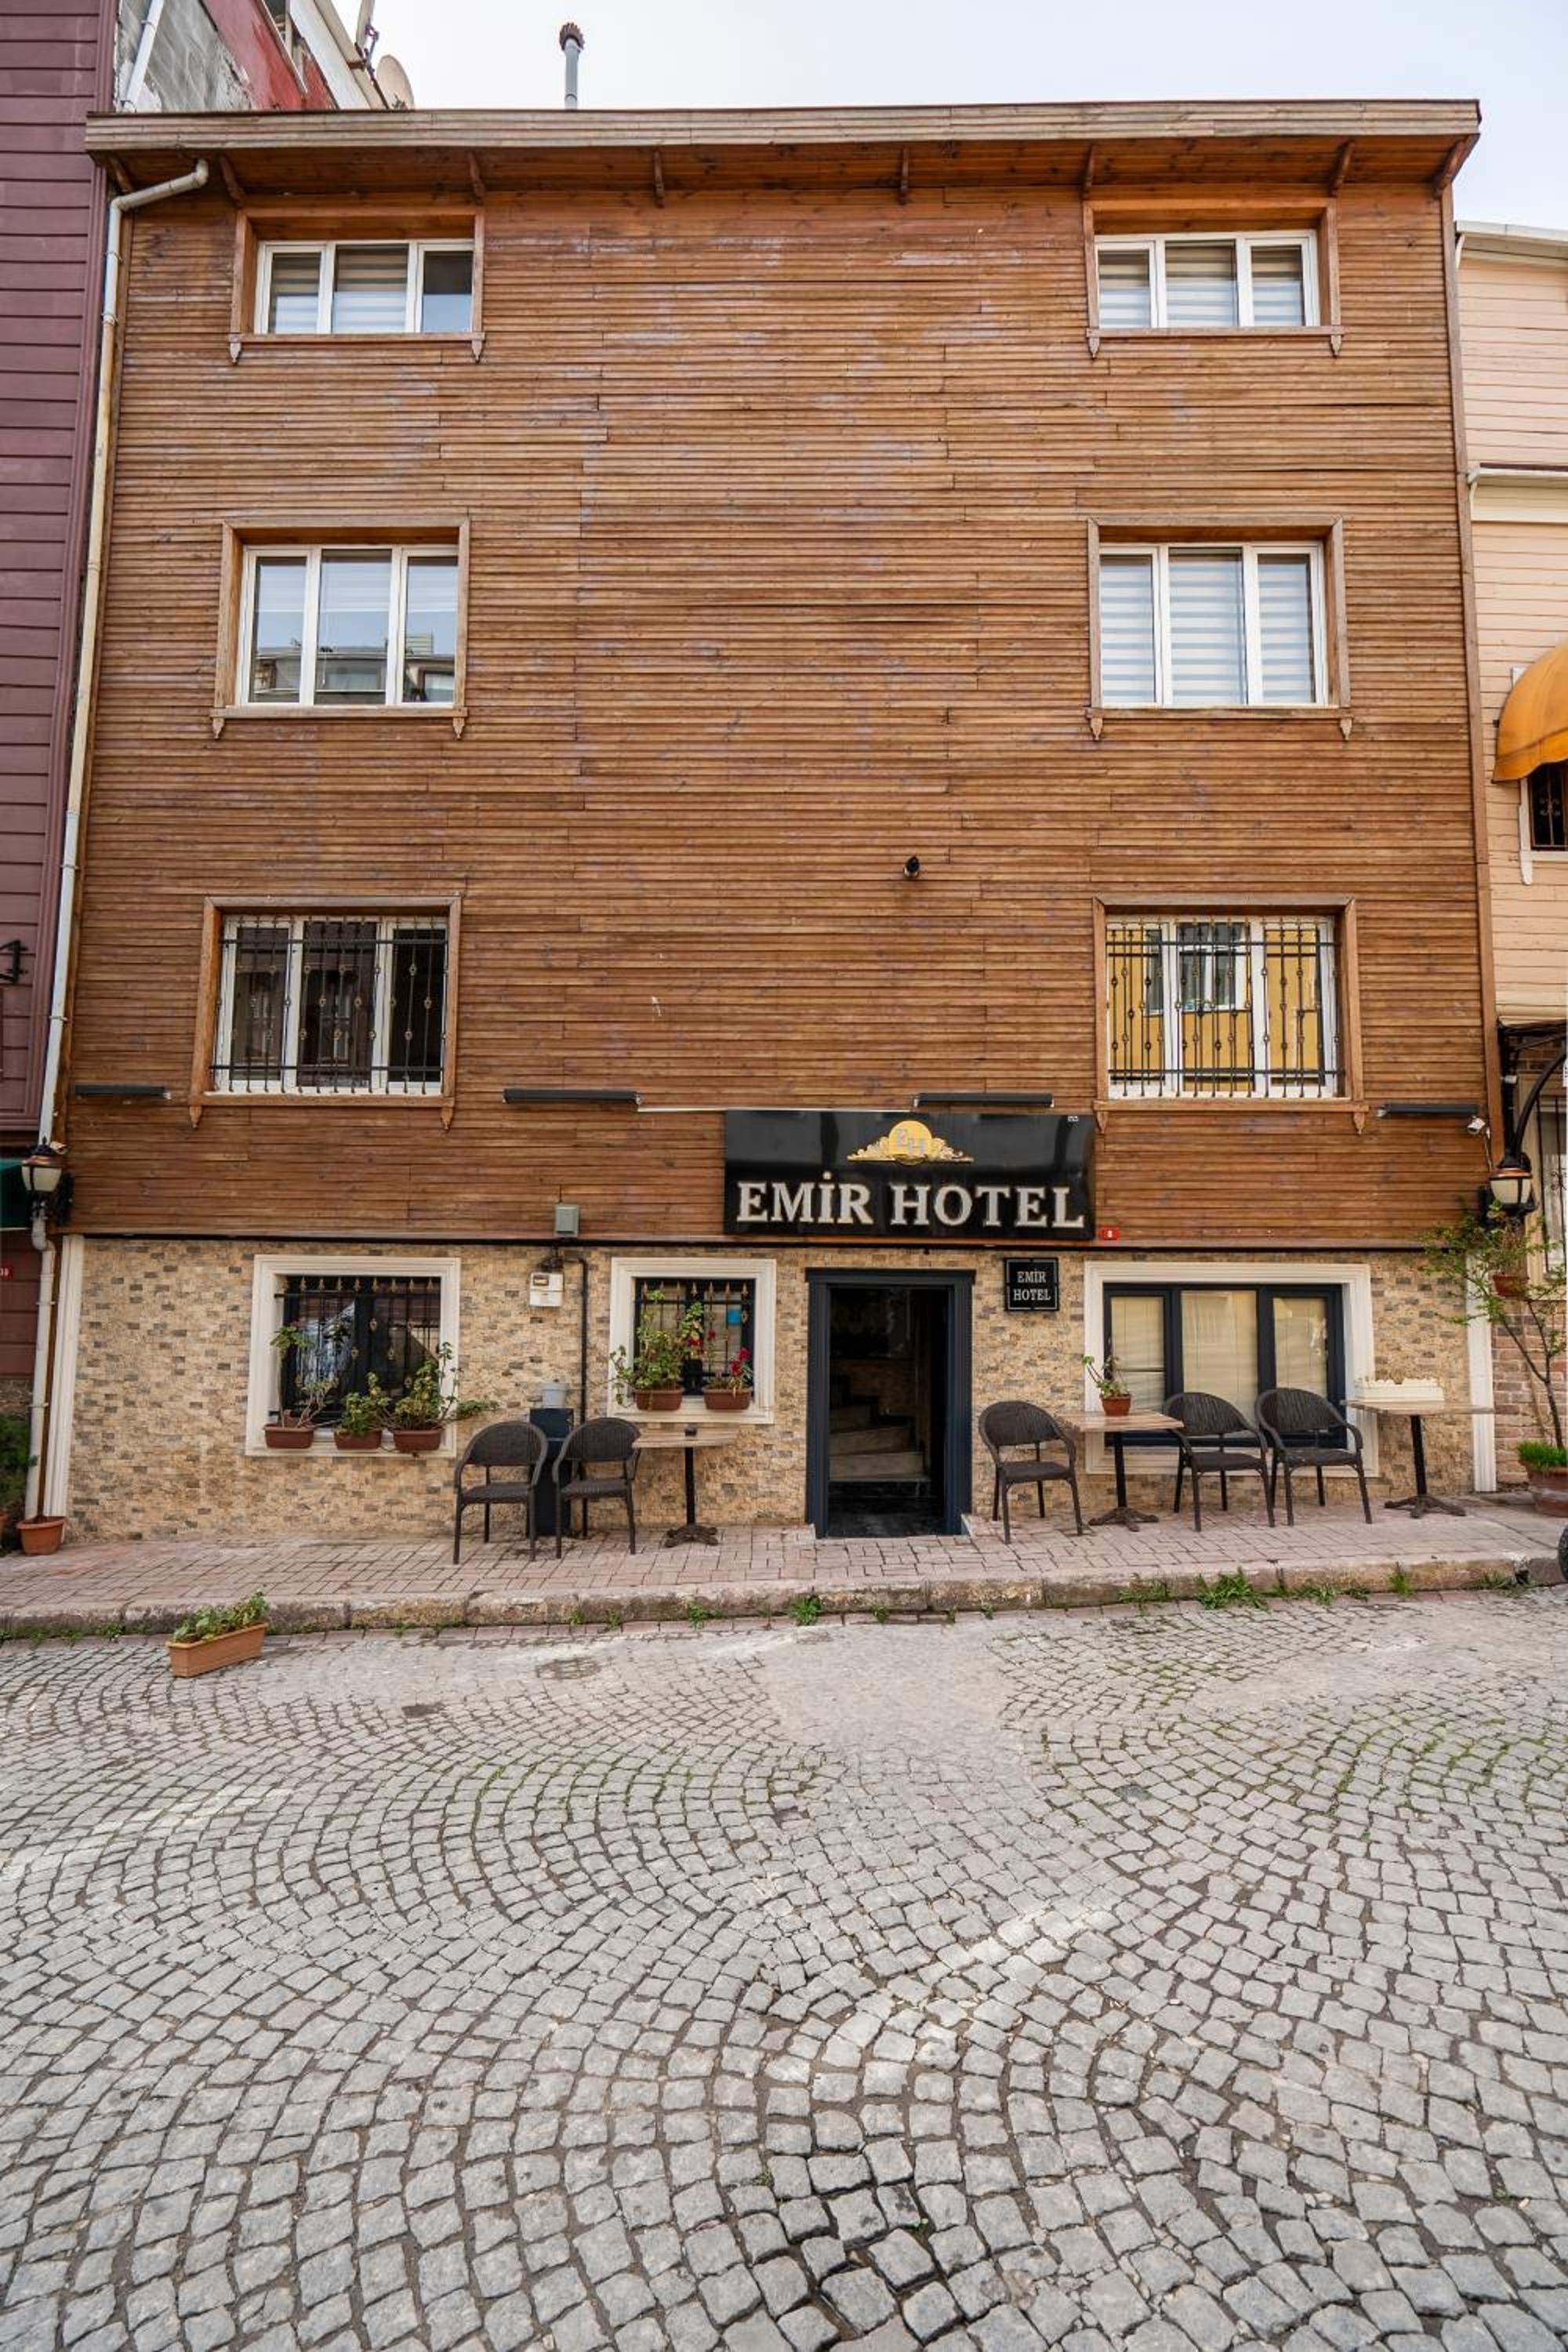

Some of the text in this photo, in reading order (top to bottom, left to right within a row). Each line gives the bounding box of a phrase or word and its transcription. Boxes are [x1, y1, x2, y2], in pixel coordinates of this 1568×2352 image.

[736, 1171, 1084, 1229] EMİR HOTEL
[1017, 1268, 1047, 1283] EMİR
[1013, 1288, 1051, 1301] HOTEL
